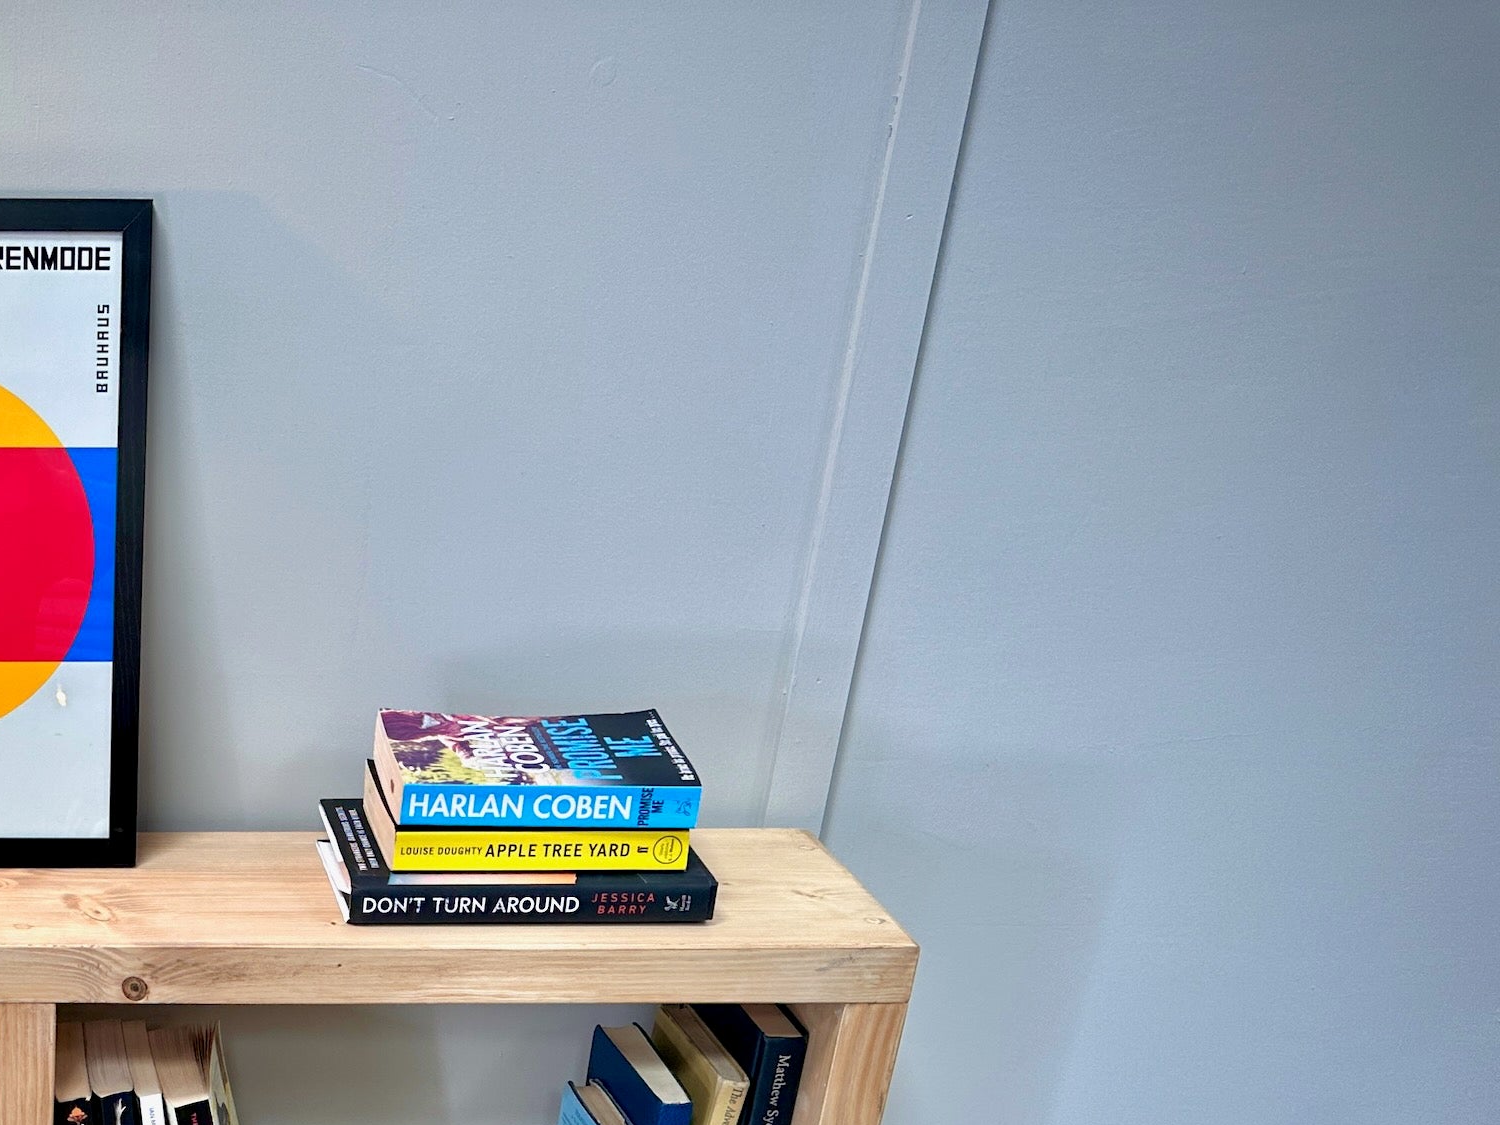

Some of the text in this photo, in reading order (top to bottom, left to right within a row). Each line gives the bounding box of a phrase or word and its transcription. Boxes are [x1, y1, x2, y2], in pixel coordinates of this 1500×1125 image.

[96, 304, 110, 393] BAUHAUS
[457, 720, 519, 779] HARLAN
[494, 725, 550, 773] COBEN
[540, 718, 623, 780] PROMISE
[603, 735, 663, 757] ME
[409, 793, 633, 820] HARLAN COBEN
[637, 787, 655, 827] PROMISE
[651, 799, 664, 814] ME
[400, 846, 434, 856] LOUISE
[438, 846, 482, 856] DOUGHTY
[485, 844, 537, 858] APPLE
[543, 843, 583, 858] TREE
[588, 843, 631, 858] YARD
[433, 897, 486, 914] TURN
[492, 896, 580, 914] AROUND
[591, 892, 656, 903] JESSICA
[597, 905, 647, 915] BARRY
[768, 1054, 791, 1107] Matthew
[731, 1086, 744, 1104] The
